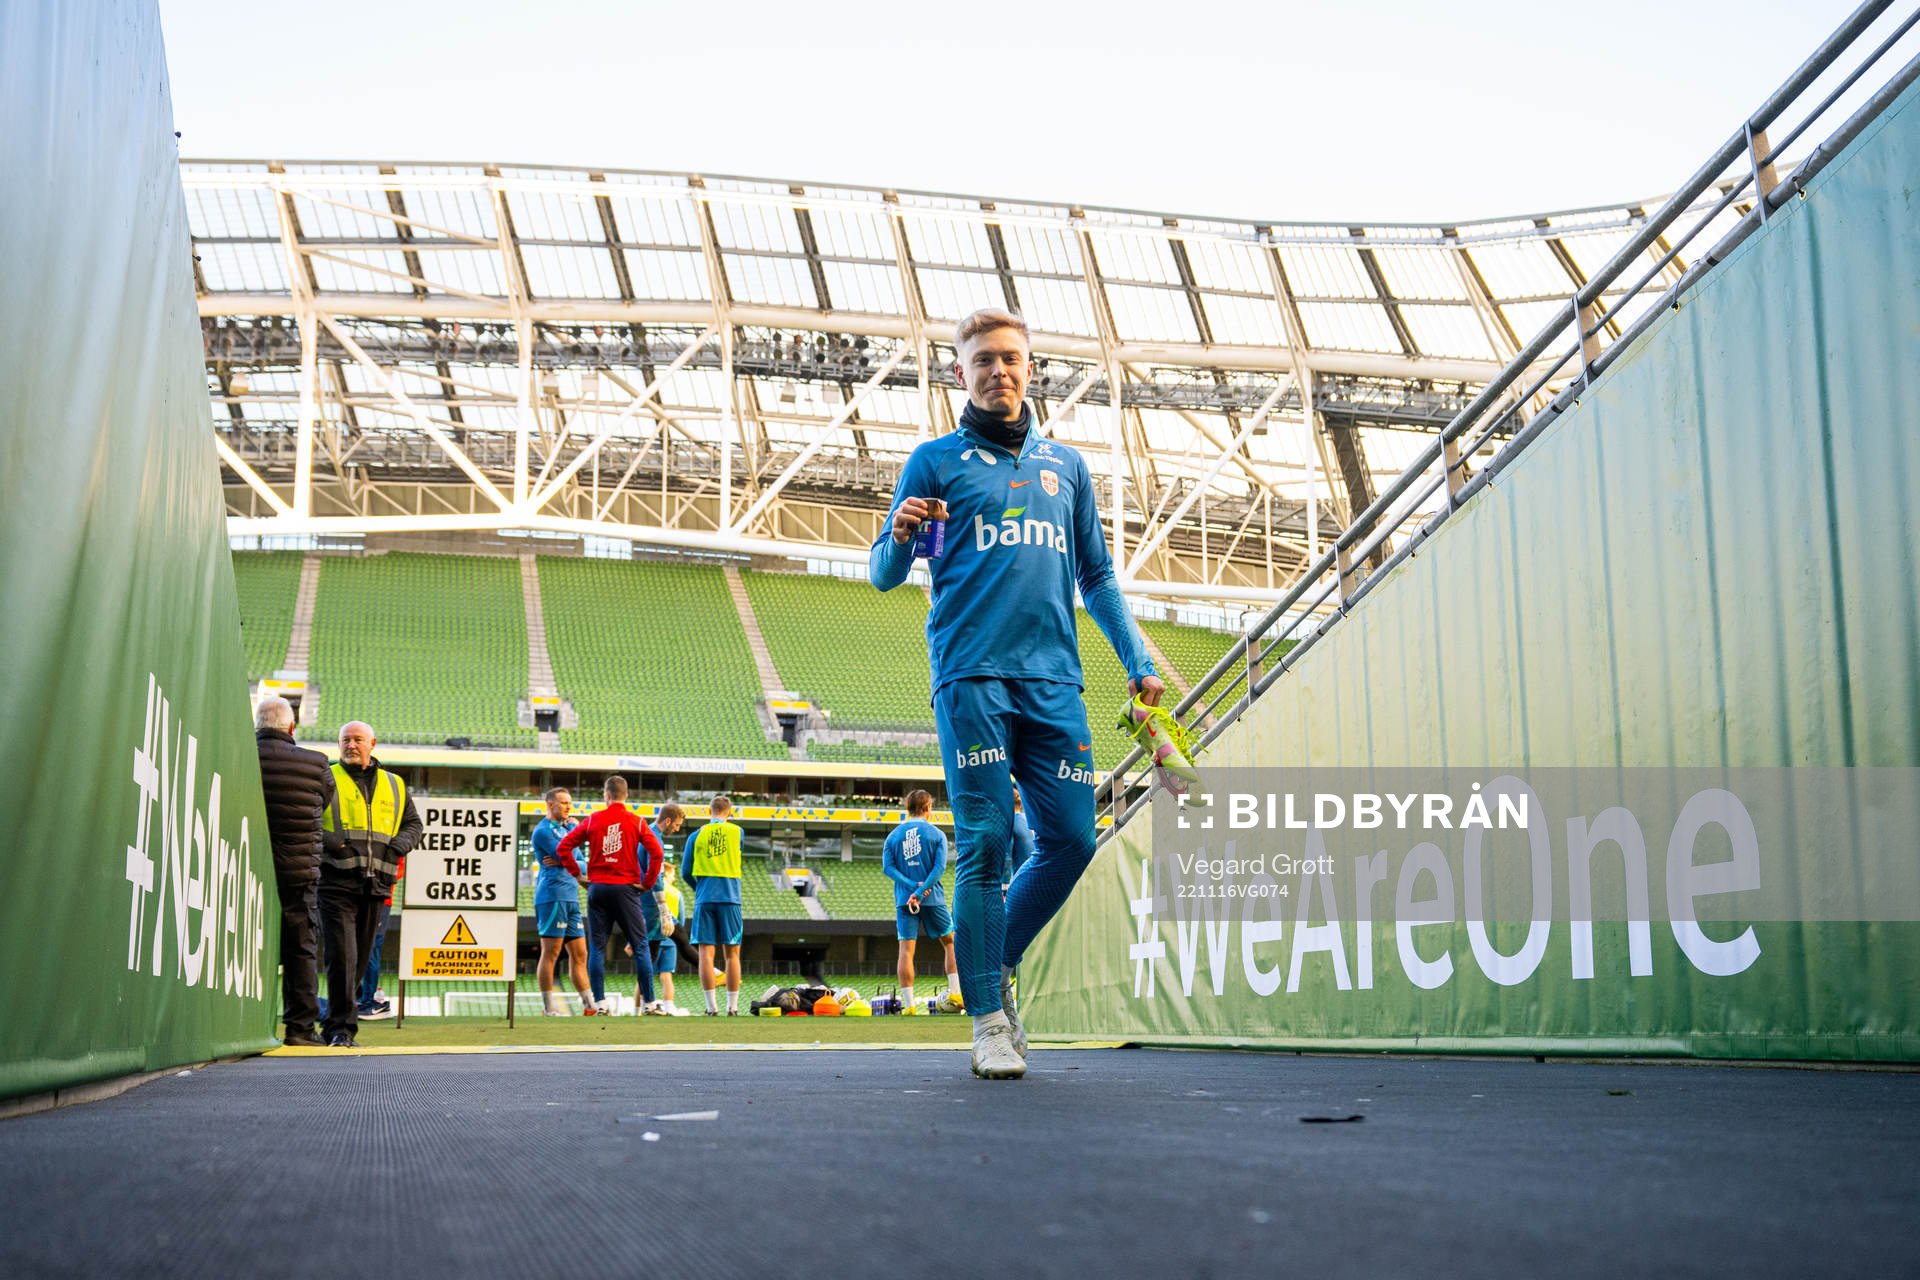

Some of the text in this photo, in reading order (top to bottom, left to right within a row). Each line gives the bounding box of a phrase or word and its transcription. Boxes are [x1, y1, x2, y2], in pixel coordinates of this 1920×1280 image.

[974, 513, 1068, 553] bama
[658, 760, 745, 772] AVIVA STADIUM
[957, 745, 1006, 769] bama
[1058, 759, 1094, 786] bam
[426, 809, 502, 828] PLEASE
[474, 834, 512, 852] OFF
[444, 858, 482, 876] THE
[426, 882, 497, 901] GRASS
[1128, 775, 1762, 998] #WeAreOne
[430, 950, 488, 960] CAUTION
